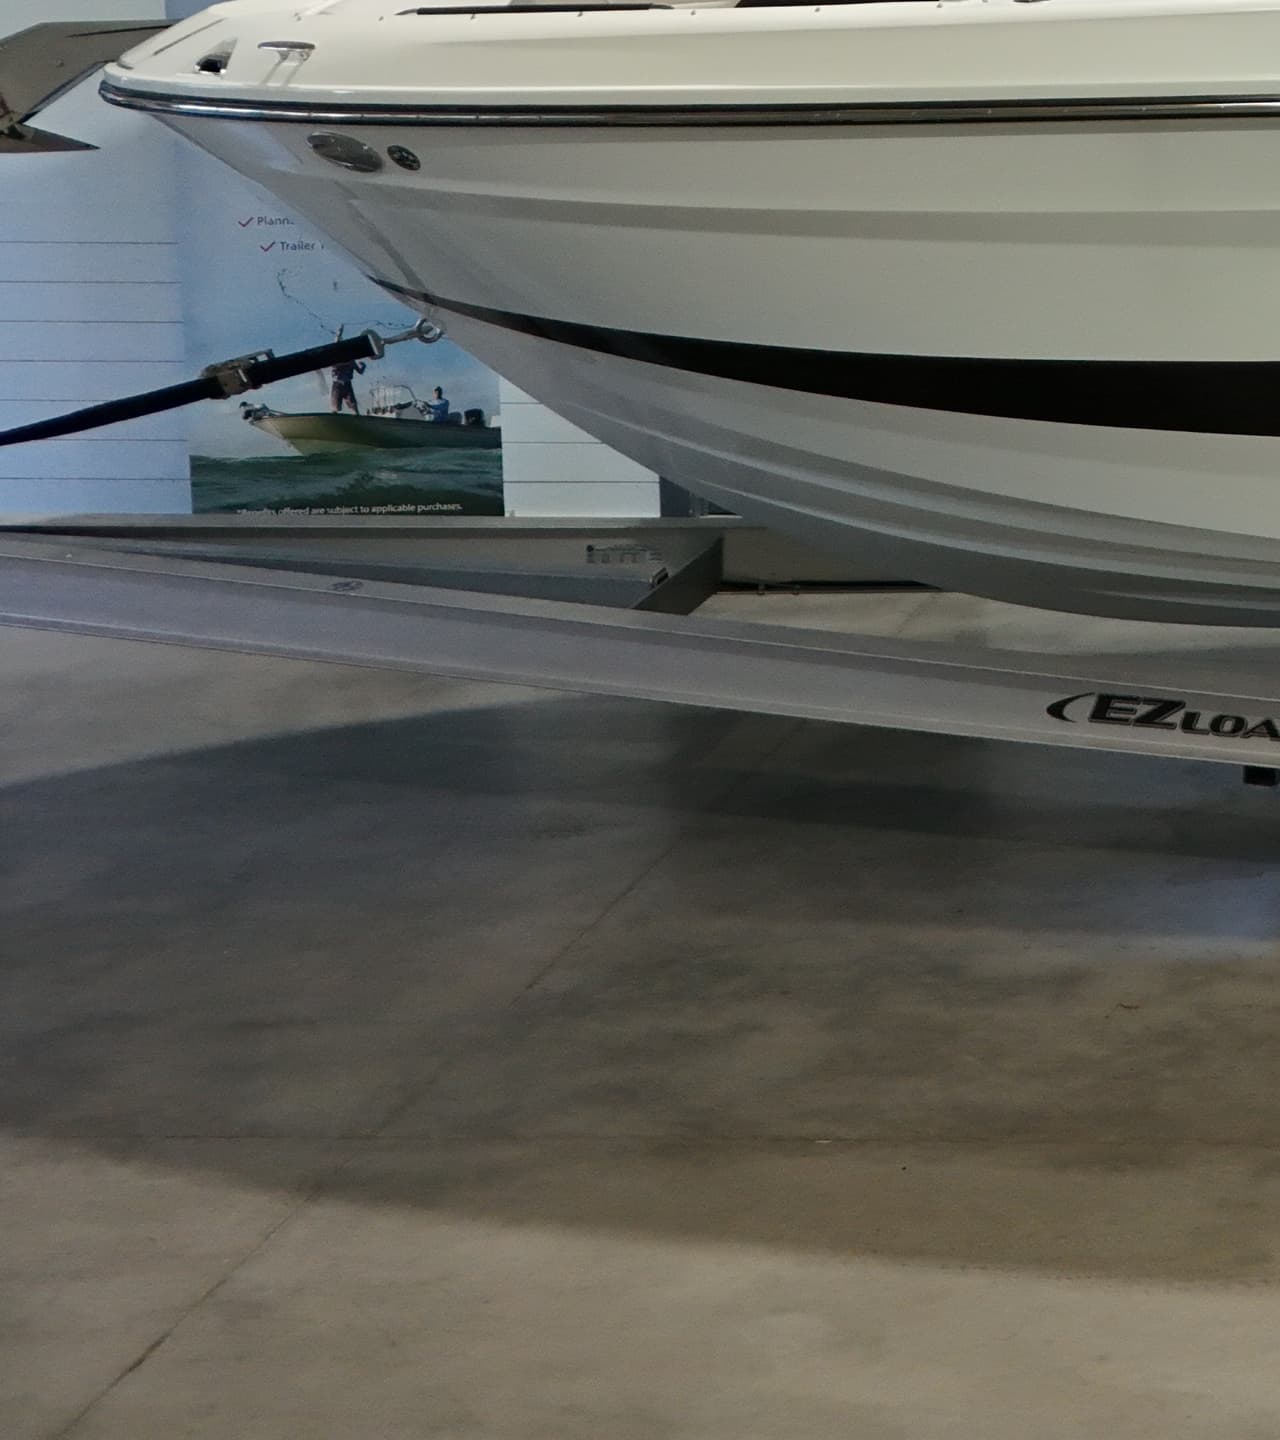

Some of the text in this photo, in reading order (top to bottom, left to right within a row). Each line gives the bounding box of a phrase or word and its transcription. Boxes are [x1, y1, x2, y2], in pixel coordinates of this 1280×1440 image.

[280, 241, 315, 251] Trailer
[371, 504, 416, 514] applicable
[417, 502, 463, 512] purchases.
